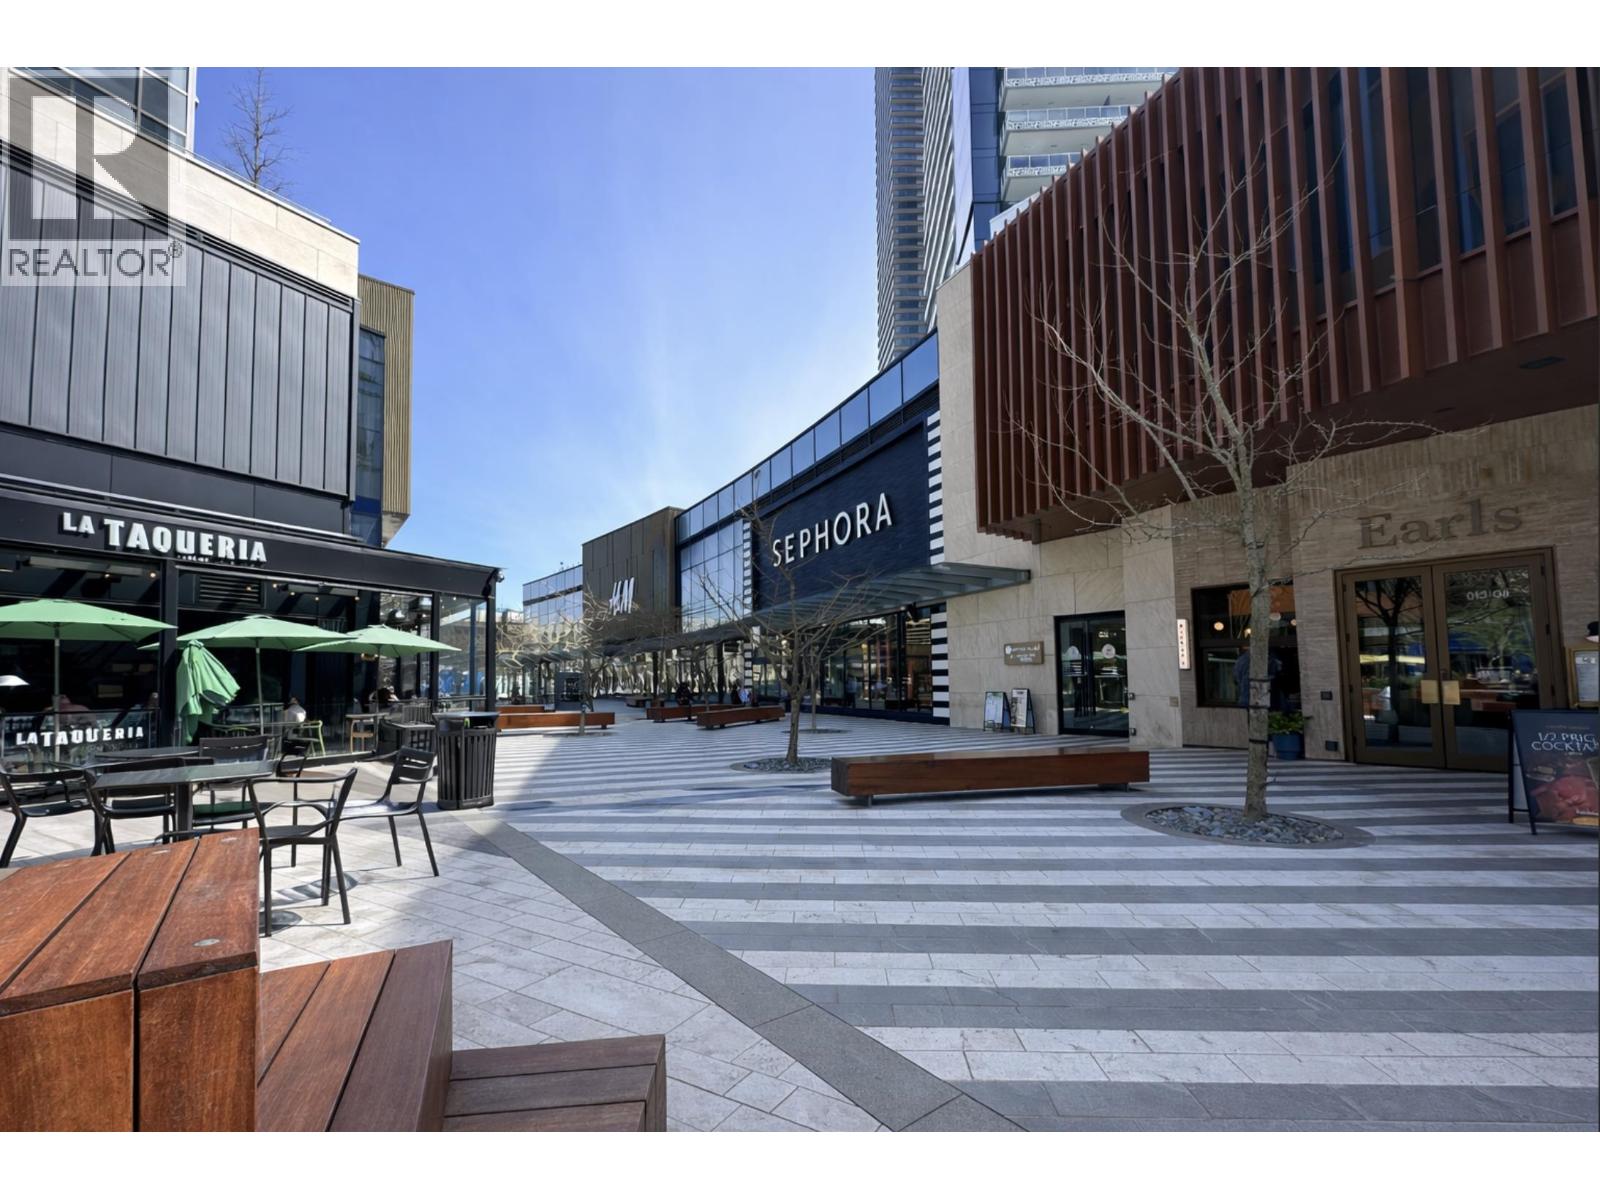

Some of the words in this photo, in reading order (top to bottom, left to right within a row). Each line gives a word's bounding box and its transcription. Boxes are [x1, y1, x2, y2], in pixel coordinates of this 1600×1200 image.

[63, 512, 95, 534] LA
[103, 518, 267, 562] TAQUERIA
[772, 492, 892, 567] SEPHORA
[1357, 498, 1523, 549] Earls
[16, 732, 38, 745] LA
[41, 726, 143, 747] TAQUERIA
[1531, 741, 1598, 752] COCKTA
